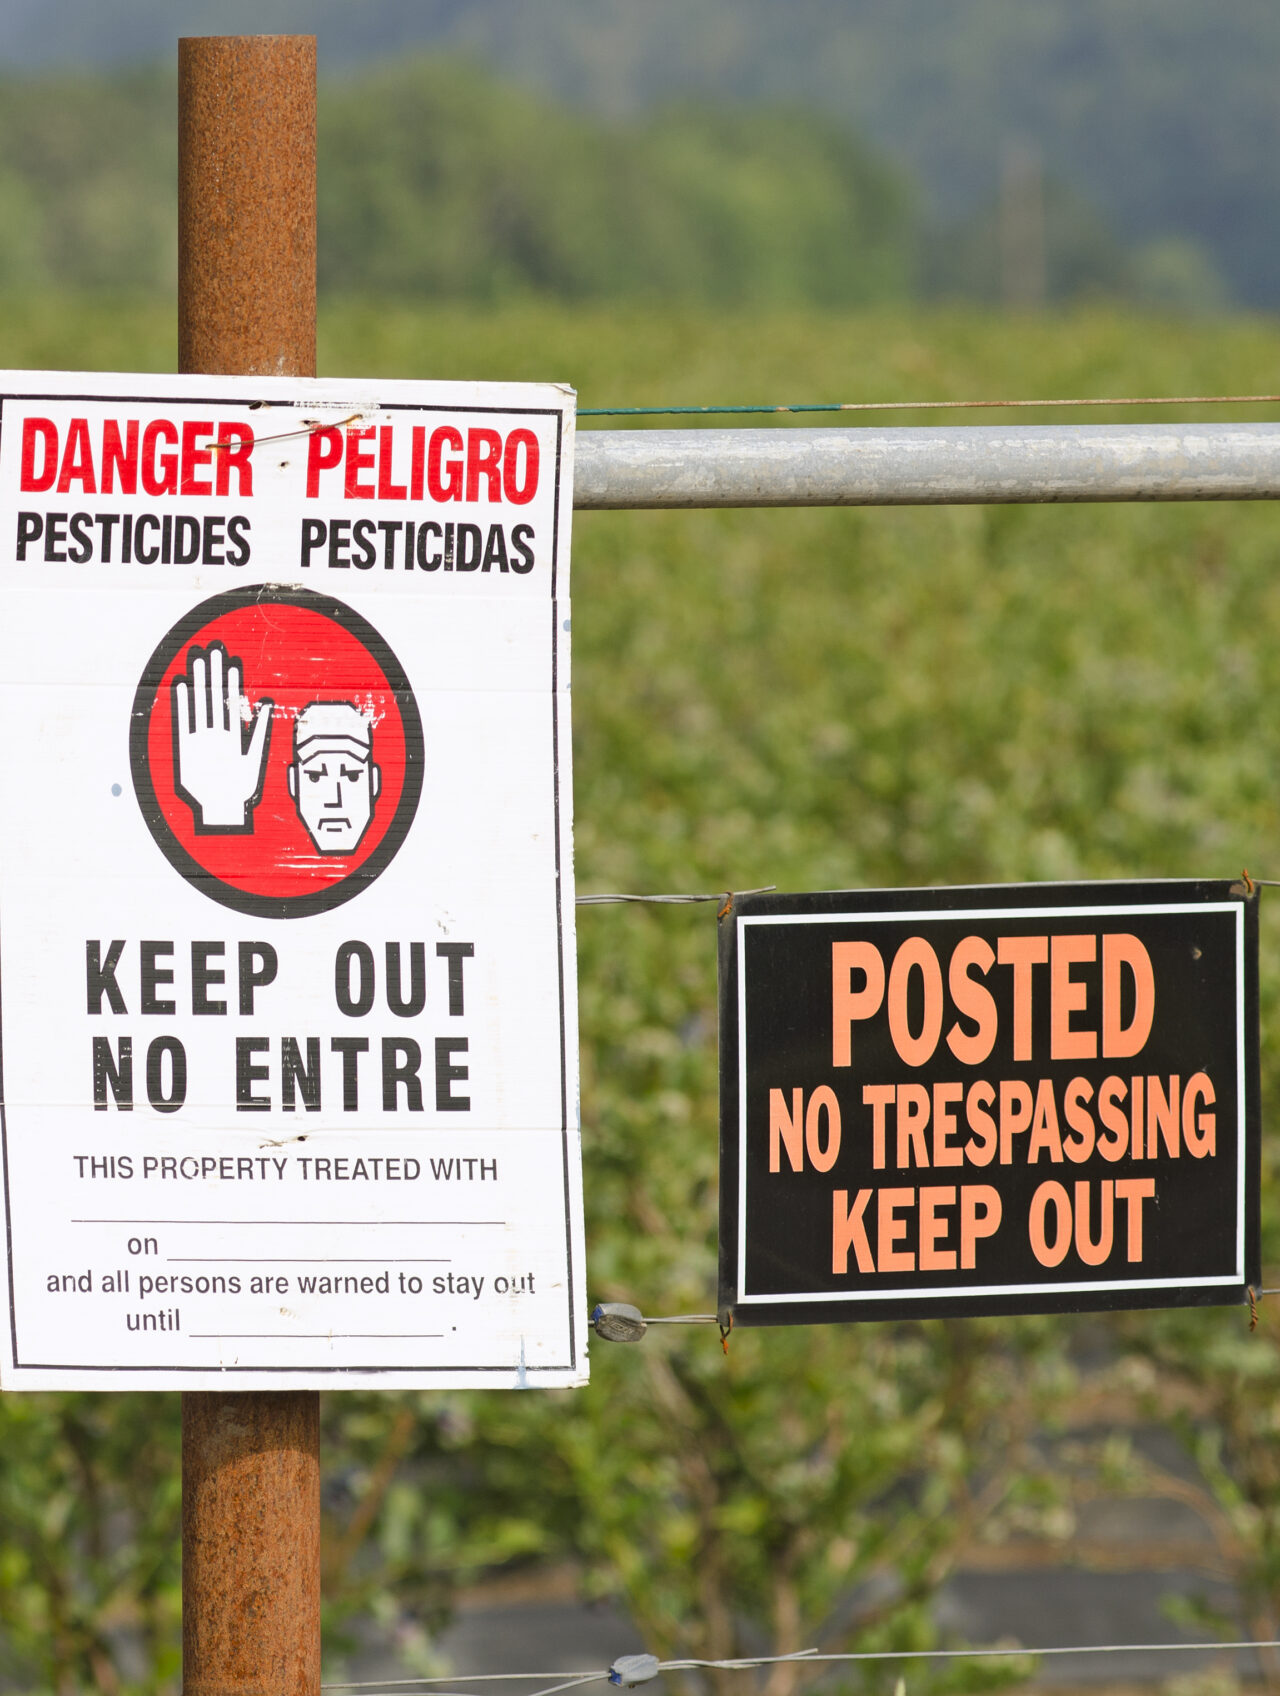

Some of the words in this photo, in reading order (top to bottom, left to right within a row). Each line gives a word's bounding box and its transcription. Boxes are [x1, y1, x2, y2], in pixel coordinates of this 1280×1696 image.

[20, 417, 253, 497] DANGER
[306, 423, 540, 505] PELIGRO
[16, 512, 251, 567] PESTICIDES
[301, 518, 535, 574] PESTICIDAS
[86, 940, 278, 1015] KEEP
[335, 940, 475, 1018] OUT
[831, 933, 1156, 1067] POSTED
[92, 1036, 187, 1113] NO
[236, 1037, 471, 1112] ENTRE
[768, 1085, 842, 1174] NO
[862, 1071, 1217, 1170] TRESPASSING
[73, 1155, 134, 1180] THIS
[143, 1156, 288, 1181] PROPERTY
[296, 1157, 421, 1181] TREATED
[429, 1158, 498, 1181] WITH
[127, 1236, 159, 1255] on
[832, 1184, 1003, 1274] KEEP
[1028, 1177, 1156, 1268] OUT
[46, 1269, 93, 1293] and
[101, 1270, 129, 1293] all
[139, 1275, 242, 1300] persons
[250, 1276, 289, 1294] are
[296, 1271, 389, 1294] warned
[398, 1272, 423, 1294] to
[432, 1272, 485, 1300] stay
[493, 1272, 536, 1295] out
[126, 1308, 181, 1332] until
